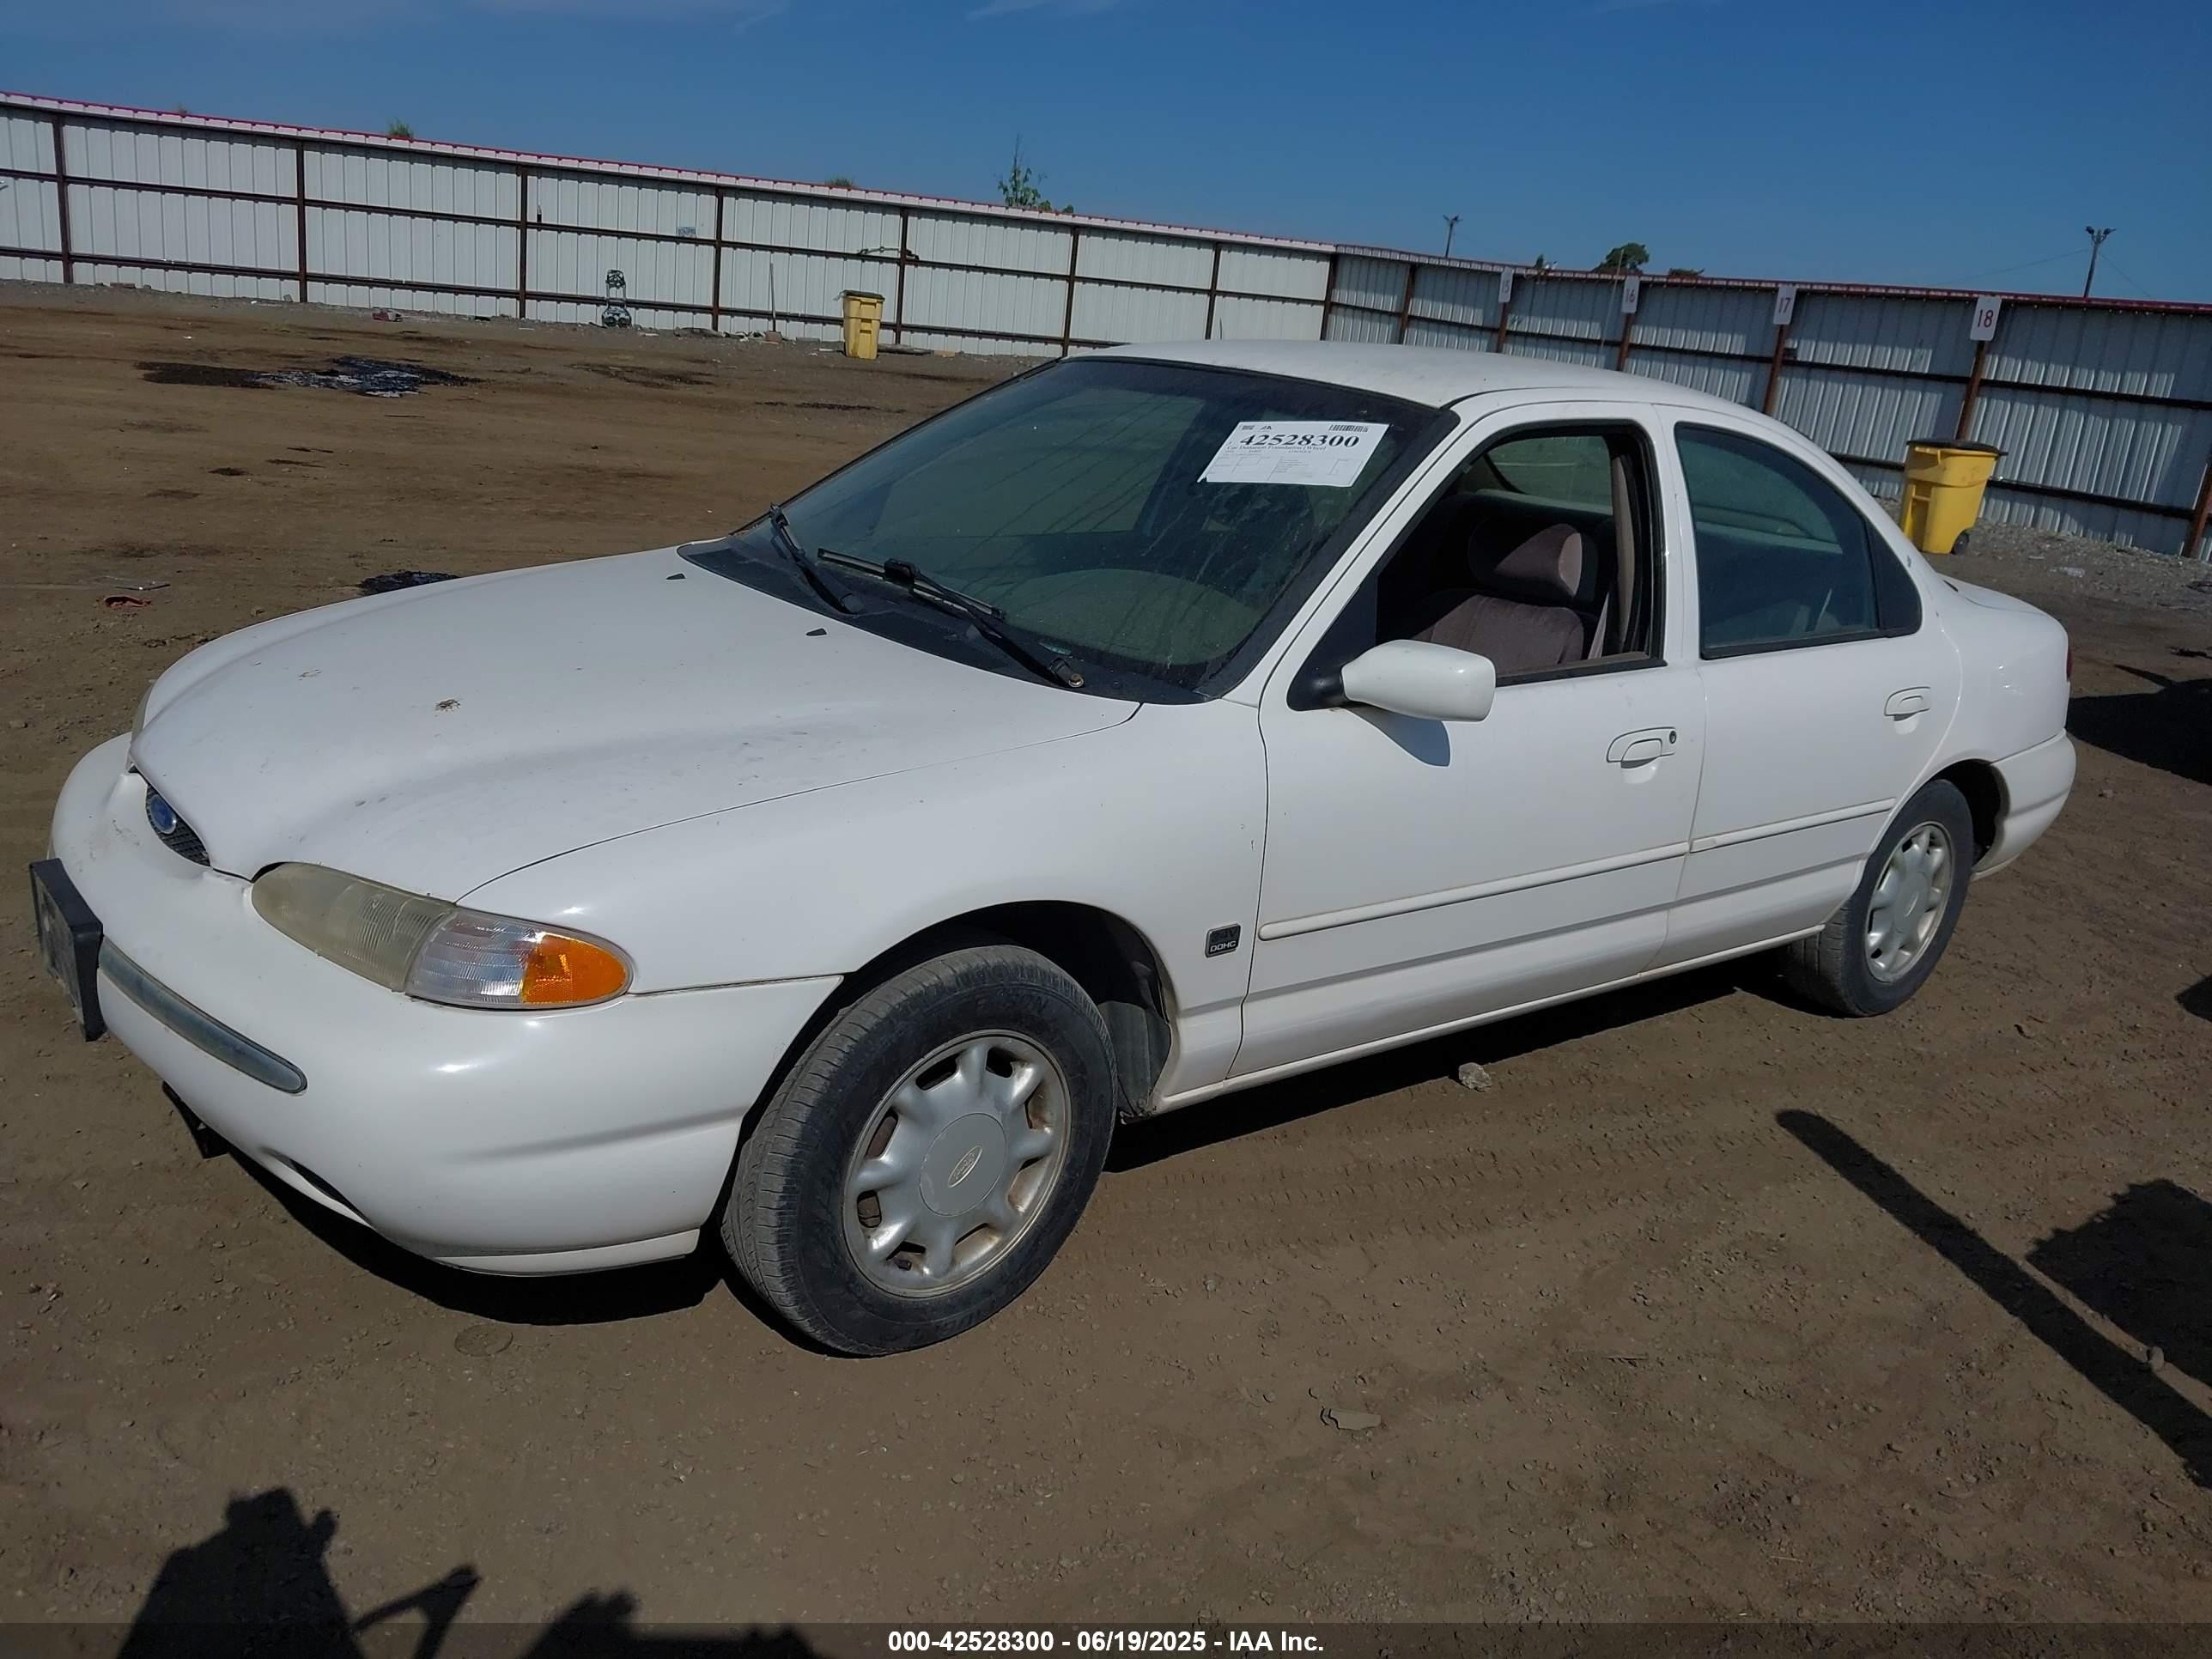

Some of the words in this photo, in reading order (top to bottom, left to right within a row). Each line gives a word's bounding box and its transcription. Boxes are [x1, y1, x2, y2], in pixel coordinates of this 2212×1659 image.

[1626, 289, 1635, 303] 16
[1778, 297, 1791, 313] 17
[1977, 309, 1994, 328] 18
[1240, 434, 1360, 448] 42528300
[1209, 940, 1237, 952] DOHC
